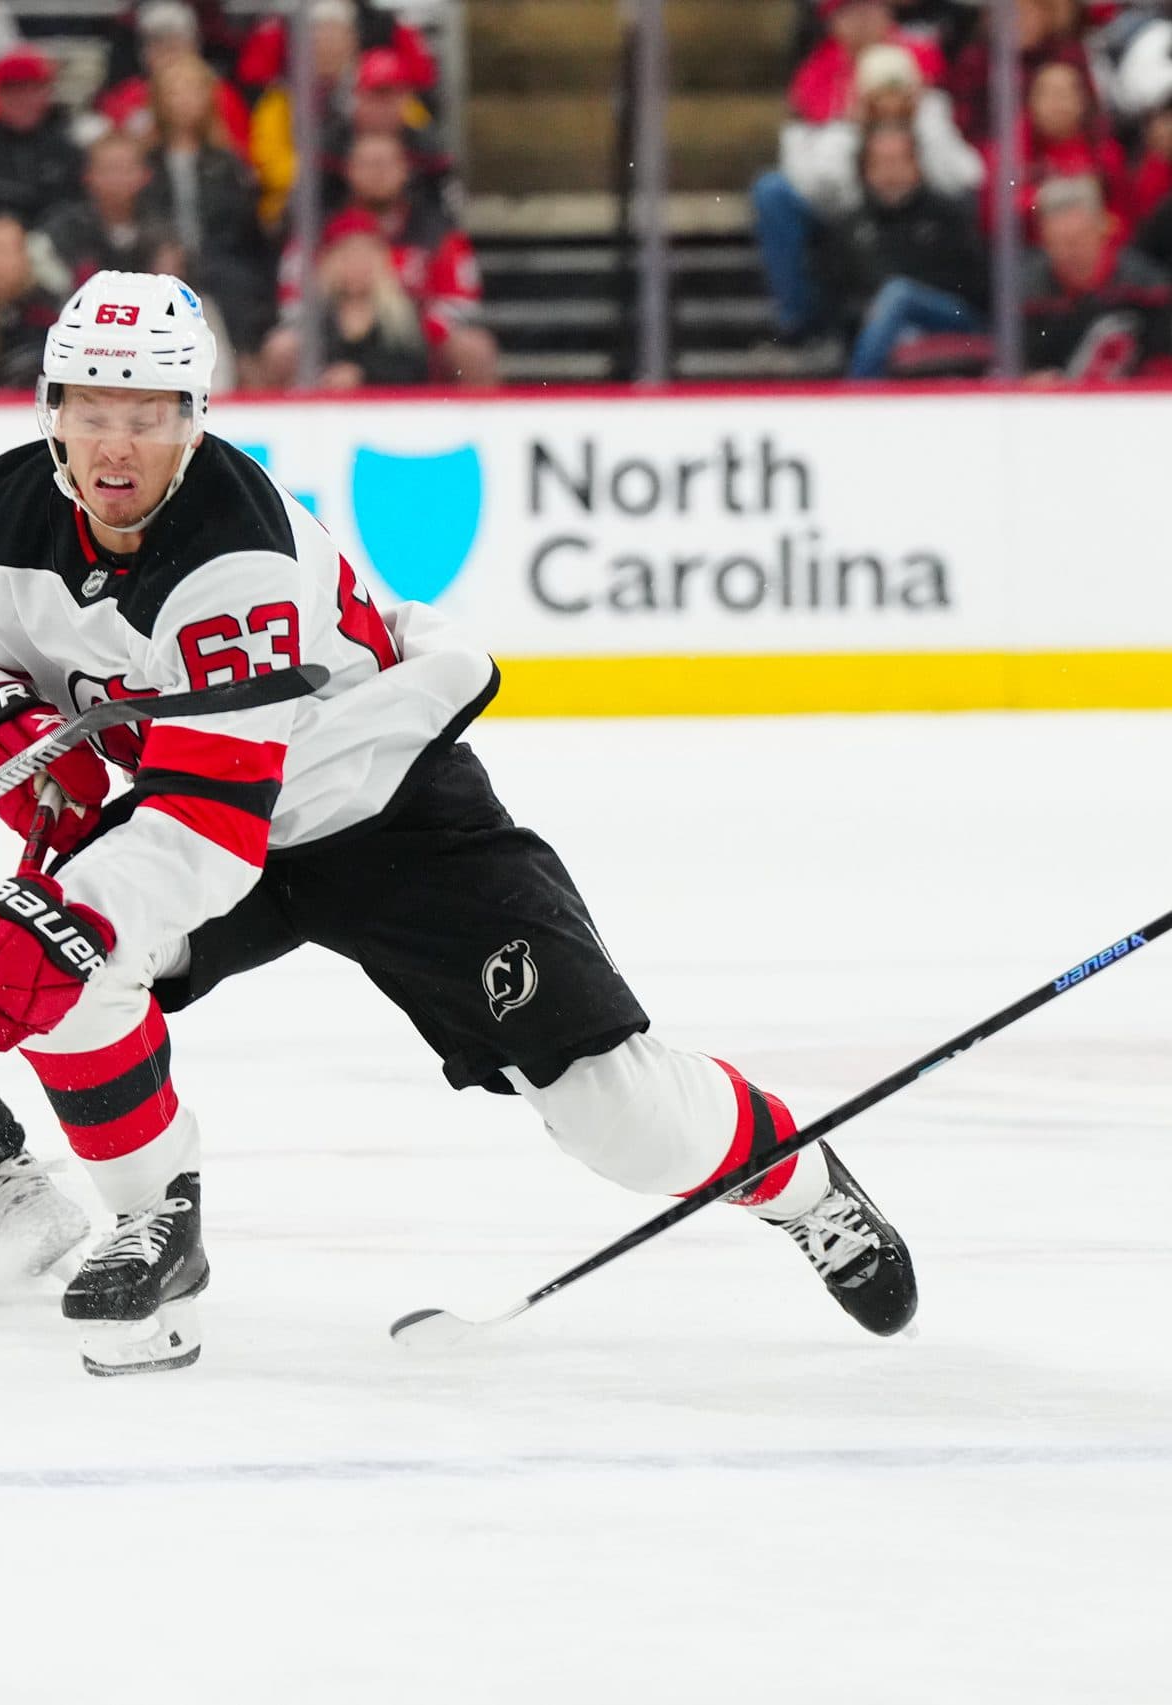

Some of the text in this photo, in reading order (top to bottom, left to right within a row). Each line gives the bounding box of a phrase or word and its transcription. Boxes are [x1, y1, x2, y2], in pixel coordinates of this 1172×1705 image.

[95, 303, 140, 326] 63
[84, 347, 137, 358] BAUER
[528, 437, 811, 515] North
[529, 532, 950, 614] Carolina
[177, 601, 301, 691] 63
[1053, 938, 1130, 993] BAUER
